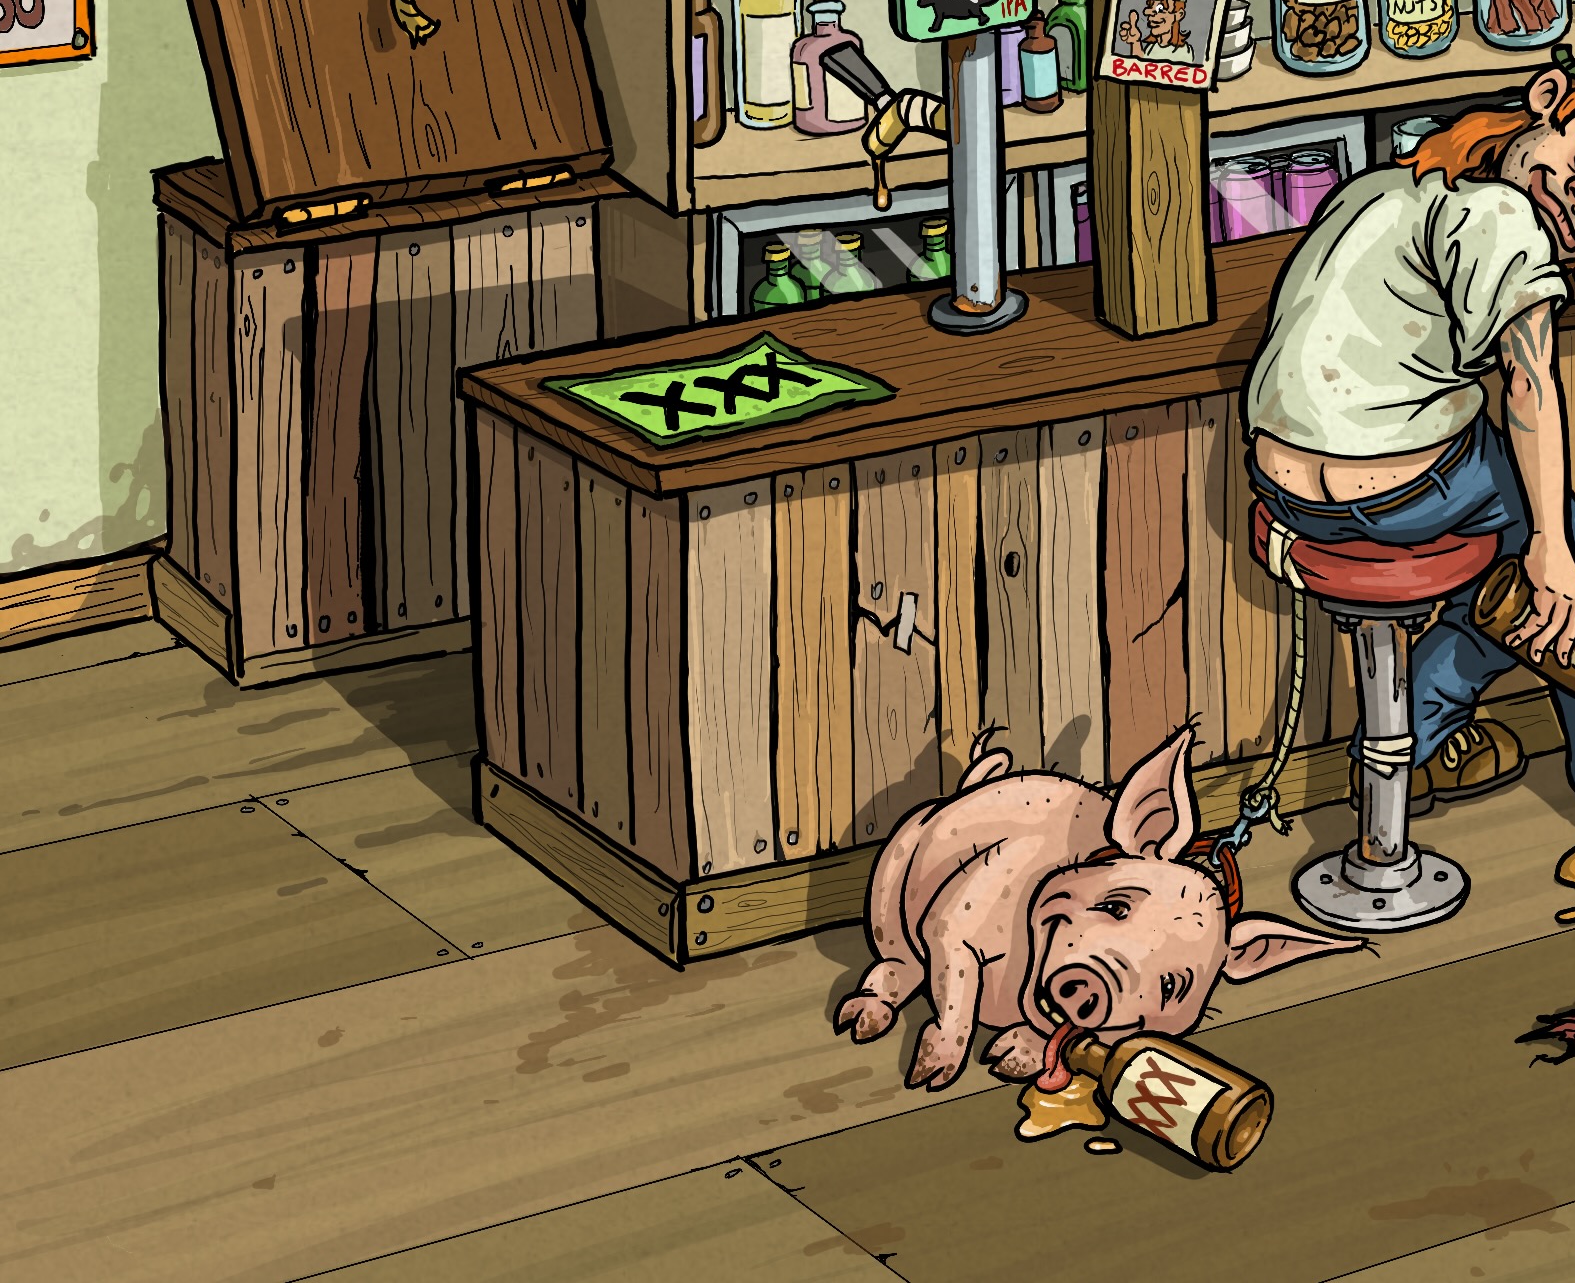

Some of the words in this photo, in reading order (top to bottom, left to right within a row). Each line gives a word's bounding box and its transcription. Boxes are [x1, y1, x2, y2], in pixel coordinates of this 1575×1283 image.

[1112, 58, 1207, 84] BARRED
[619, 352, 822, 431] XXX
[1127, 1056, 1196, 1144] XXX
